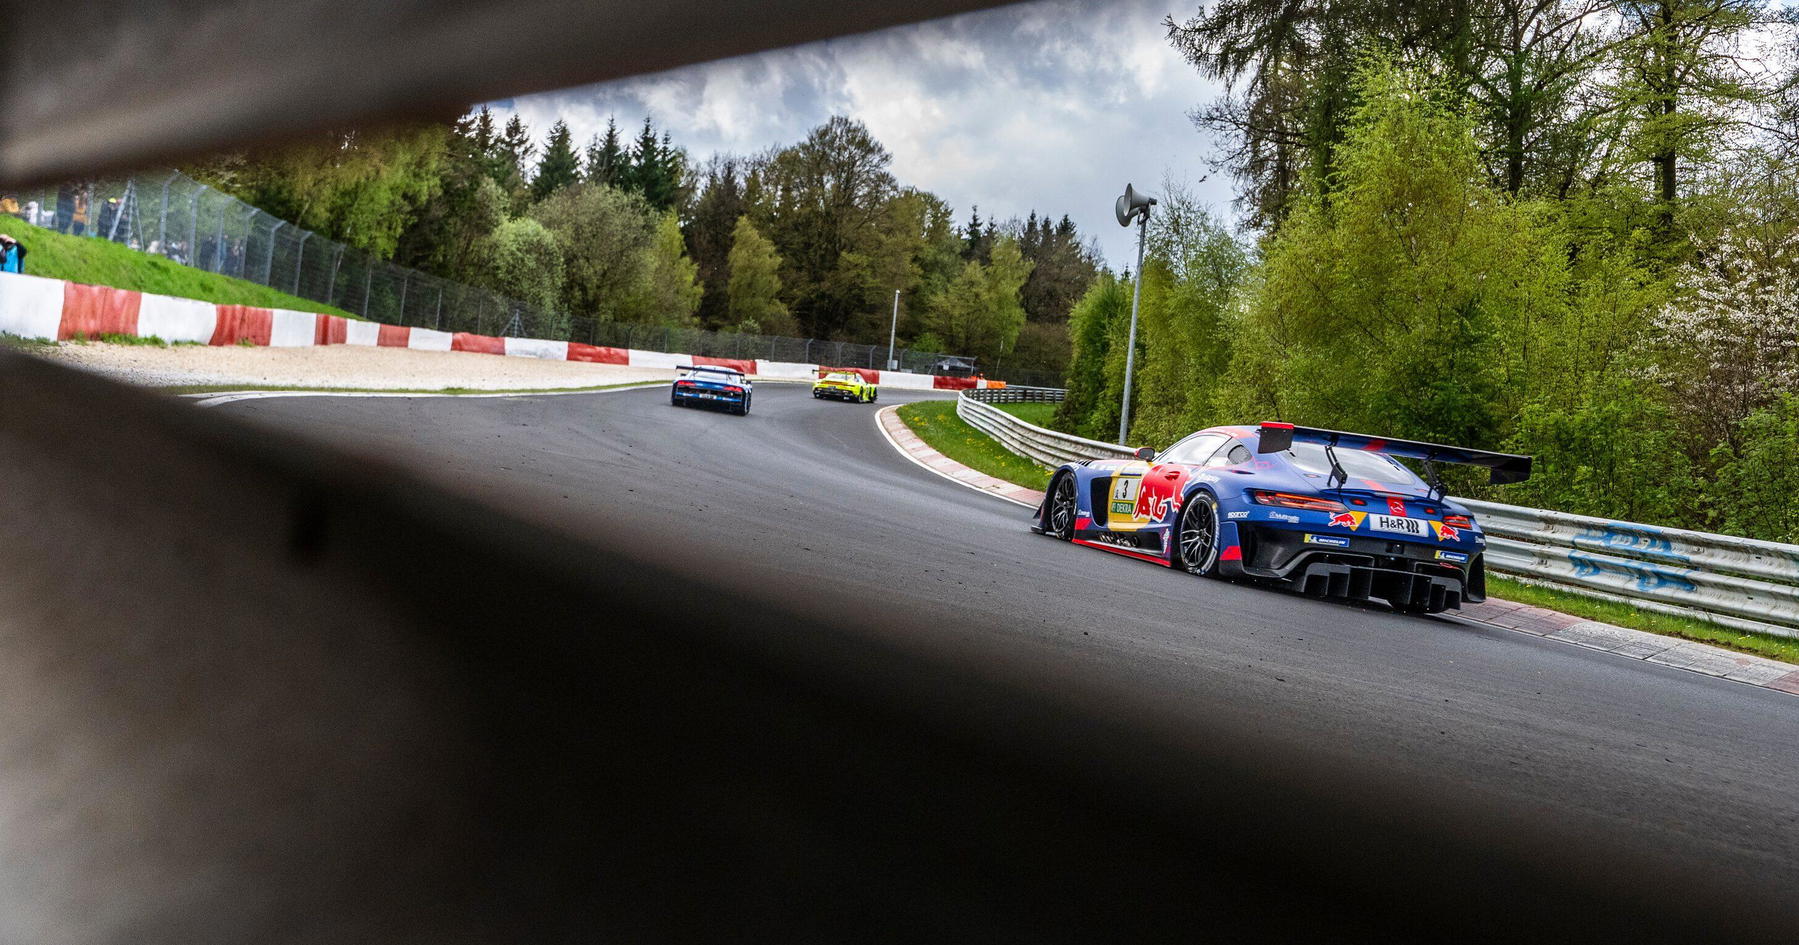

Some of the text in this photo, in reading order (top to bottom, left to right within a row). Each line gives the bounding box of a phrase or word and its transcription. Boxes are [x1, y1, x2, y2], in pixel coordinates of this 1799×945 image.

[1122, 479, 1129, 499] 3
[1116, 502, 1132, 514] DEKRA
[1379, 516, 1405, 530] H&R
